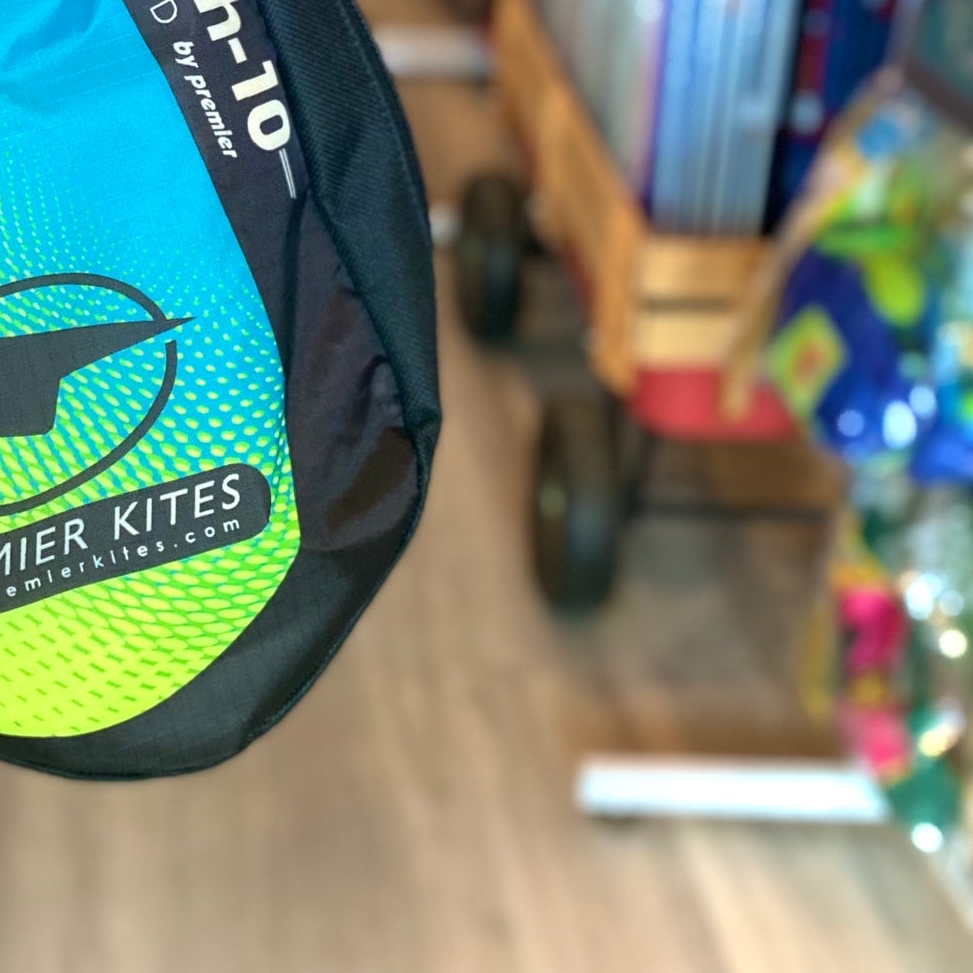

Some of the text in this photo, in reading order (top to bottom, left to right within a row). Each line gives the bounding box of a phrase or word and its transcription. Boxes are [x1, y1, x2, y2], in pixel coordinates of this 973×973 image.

[172, 40, 238, 159] by premier
[112, 472, 241, 541] KITES
